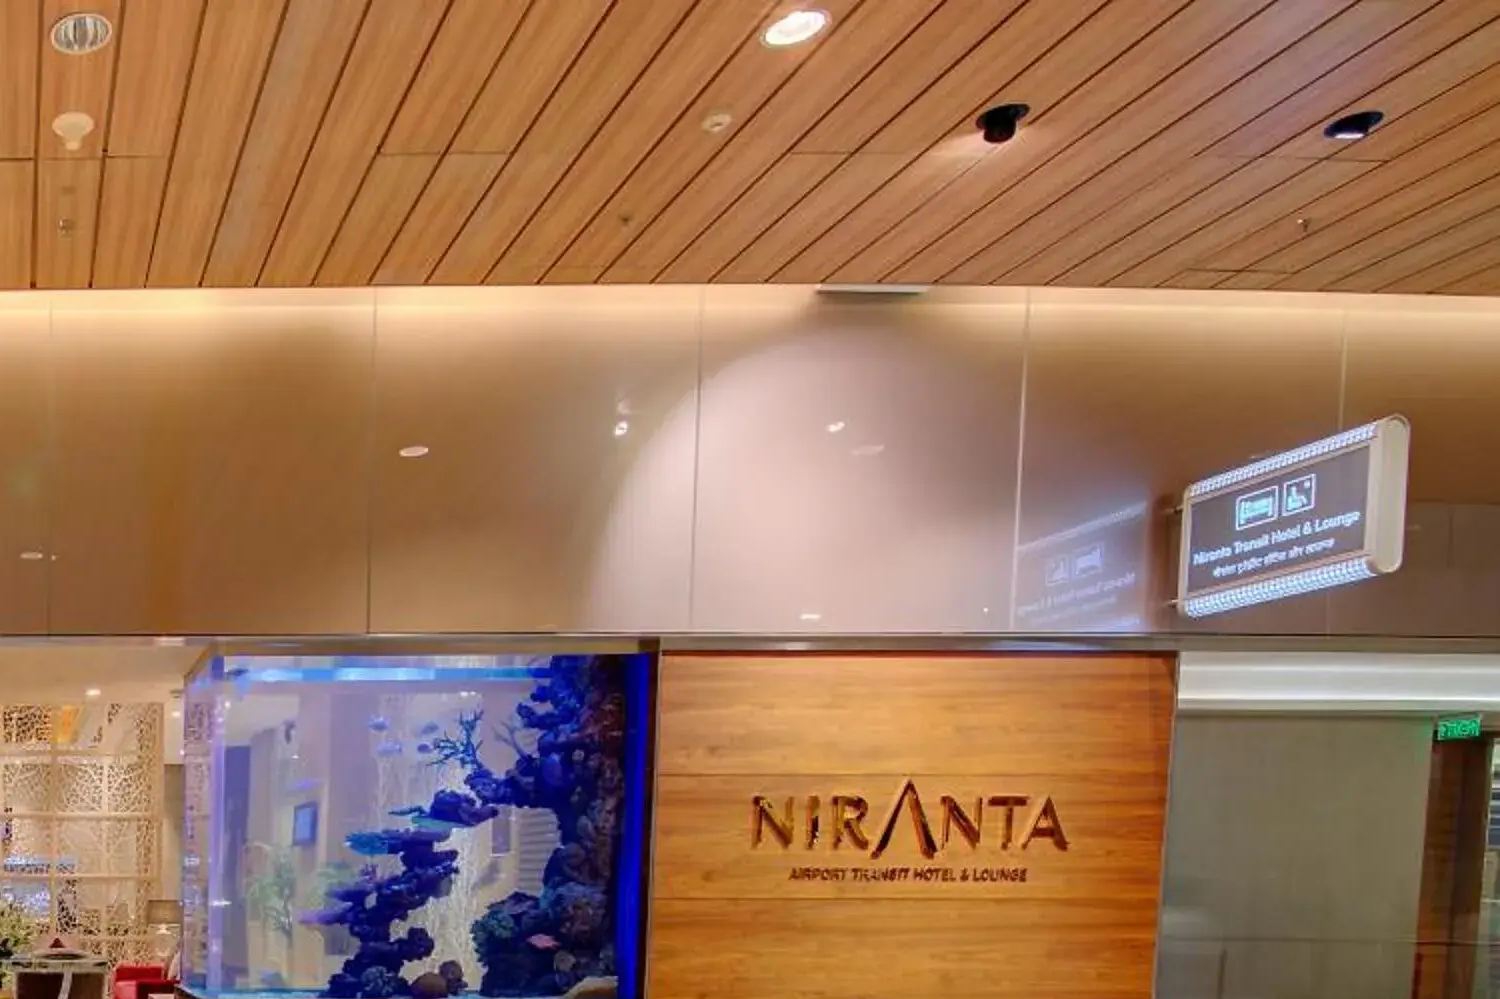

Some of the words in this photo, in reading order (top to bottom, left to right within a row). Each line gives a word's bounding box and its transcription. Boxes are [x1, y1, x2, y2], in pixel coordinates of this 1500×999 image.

[1233, 533, 1270, 554] Transit
[1271, 522, 1301, 544] Hotel
[1302, 520, 1312, 535] &
[1314, 511, 1360, 532] Lounge
[750, 775, 1070, 860] NIRANTA
[788, 866, 847, 881] AIRPORT
[850, 866, 910, 882] TRANSIT
[913, 866, 956, 882] HOTEL
[959, 866, 970, 882] &
[972, 866, 1028, 882] LOUNGE
